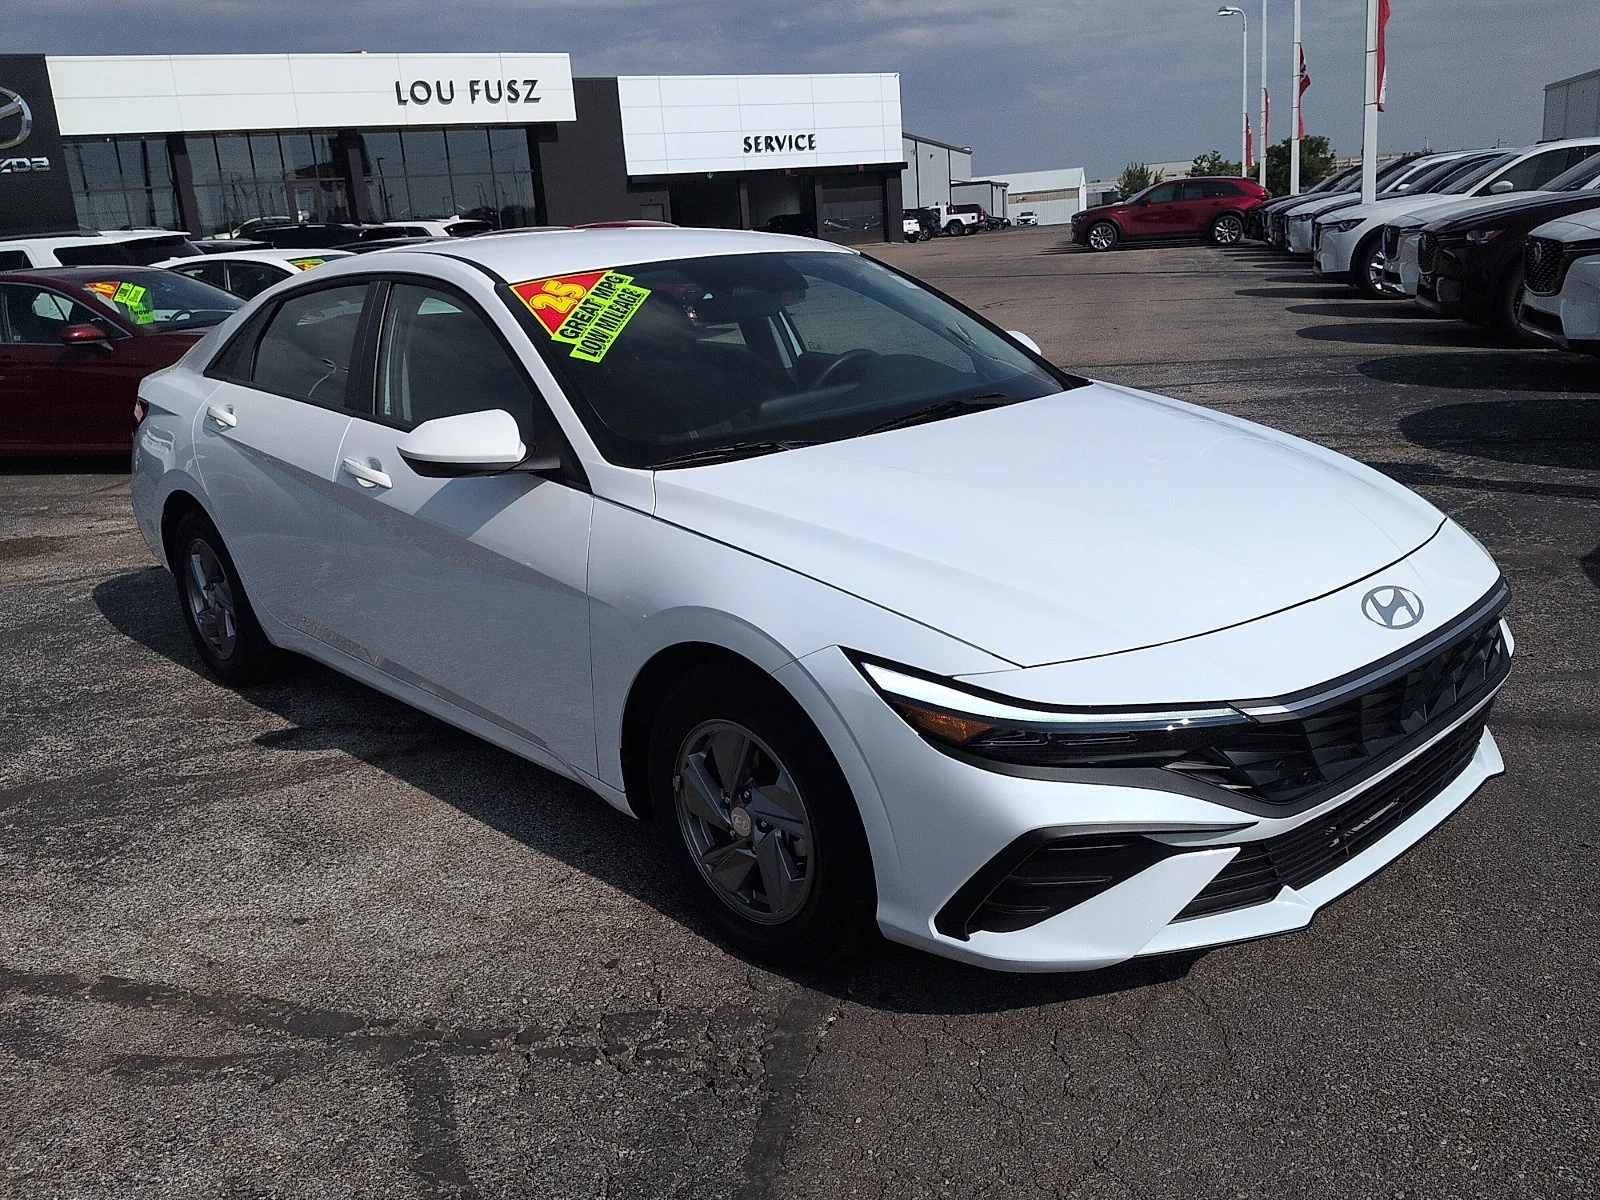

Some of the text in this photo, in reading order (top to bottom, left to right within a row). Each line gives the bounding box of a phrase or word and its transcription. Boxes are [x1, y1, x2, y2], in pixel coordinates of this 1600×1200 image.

[395, 79, 542, 105] LOU FUSZ
[743, 133, 817, 153] SERVICE
[529, 279, 587, 314] 25
[559, 272, 626, 339] GREAT MPG
[576, 287, 644, 357] LOW MILEAGE
